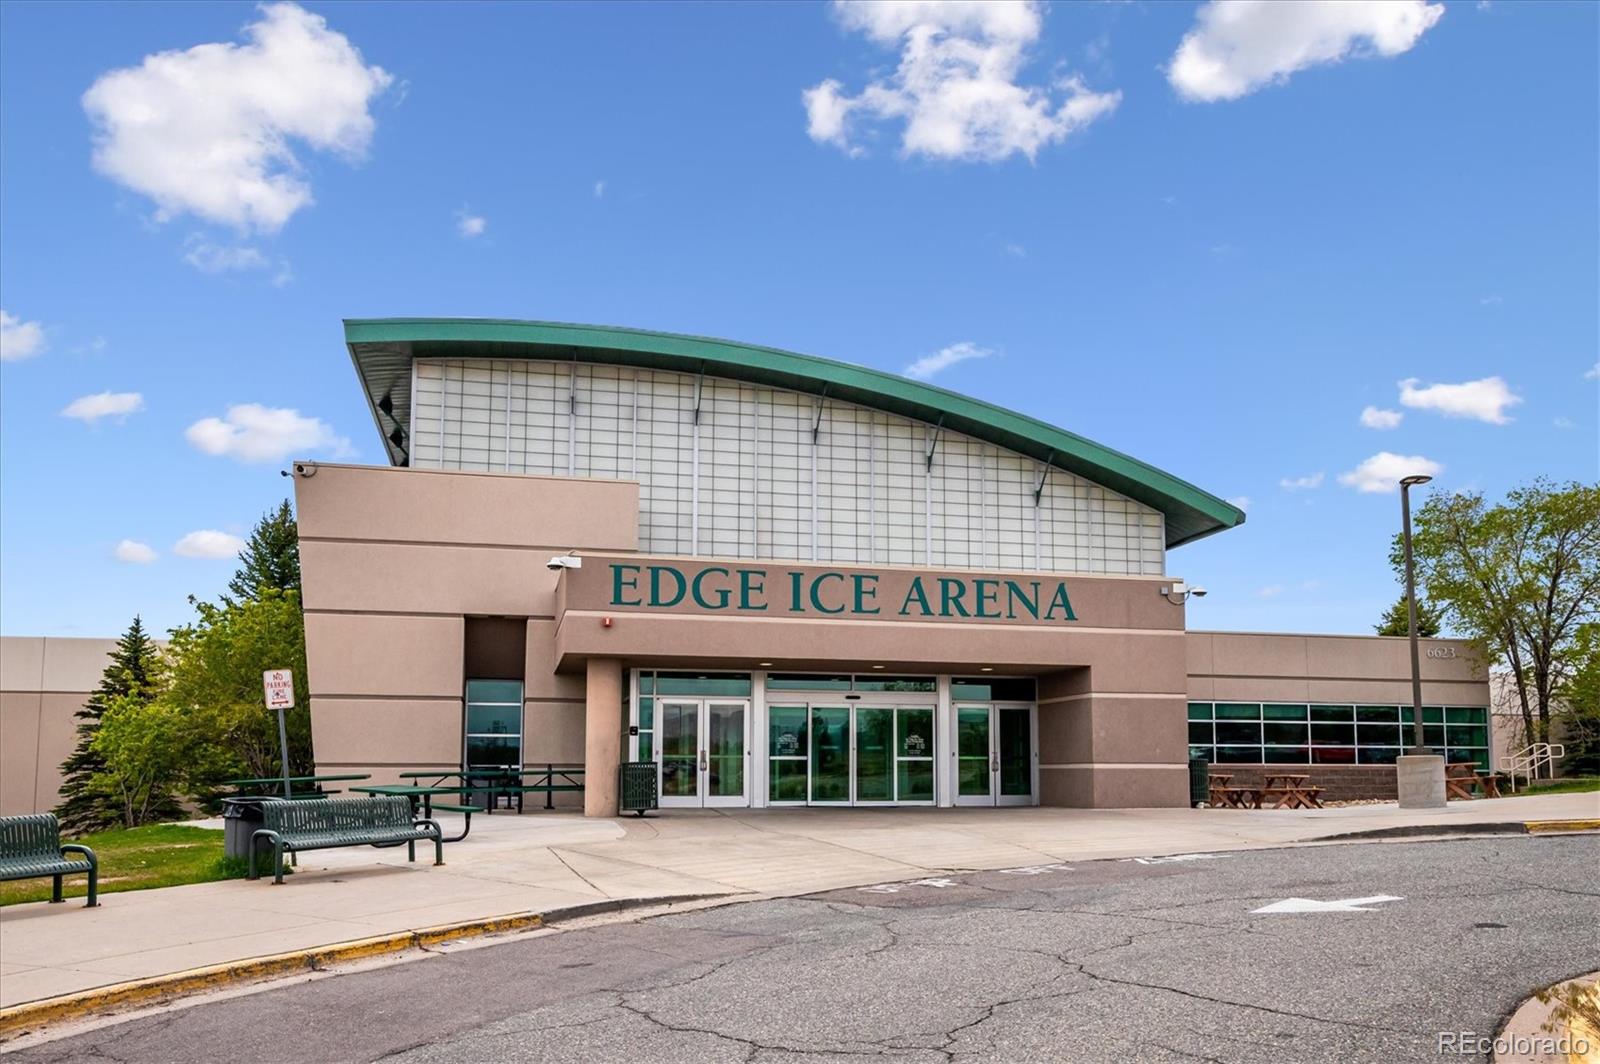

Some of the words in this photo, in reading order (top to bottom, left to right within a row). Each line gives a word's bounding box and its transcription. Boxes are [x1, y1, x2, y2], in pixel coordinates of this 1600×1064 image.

[609, 564, 768, 611] EDGE
[787, 571, 880, 614] ICE
[899, 577, 1078, 621] ARENA
[1427, 647, 1456, 658] 6623
[266, 680, 291, 688] PARKING
